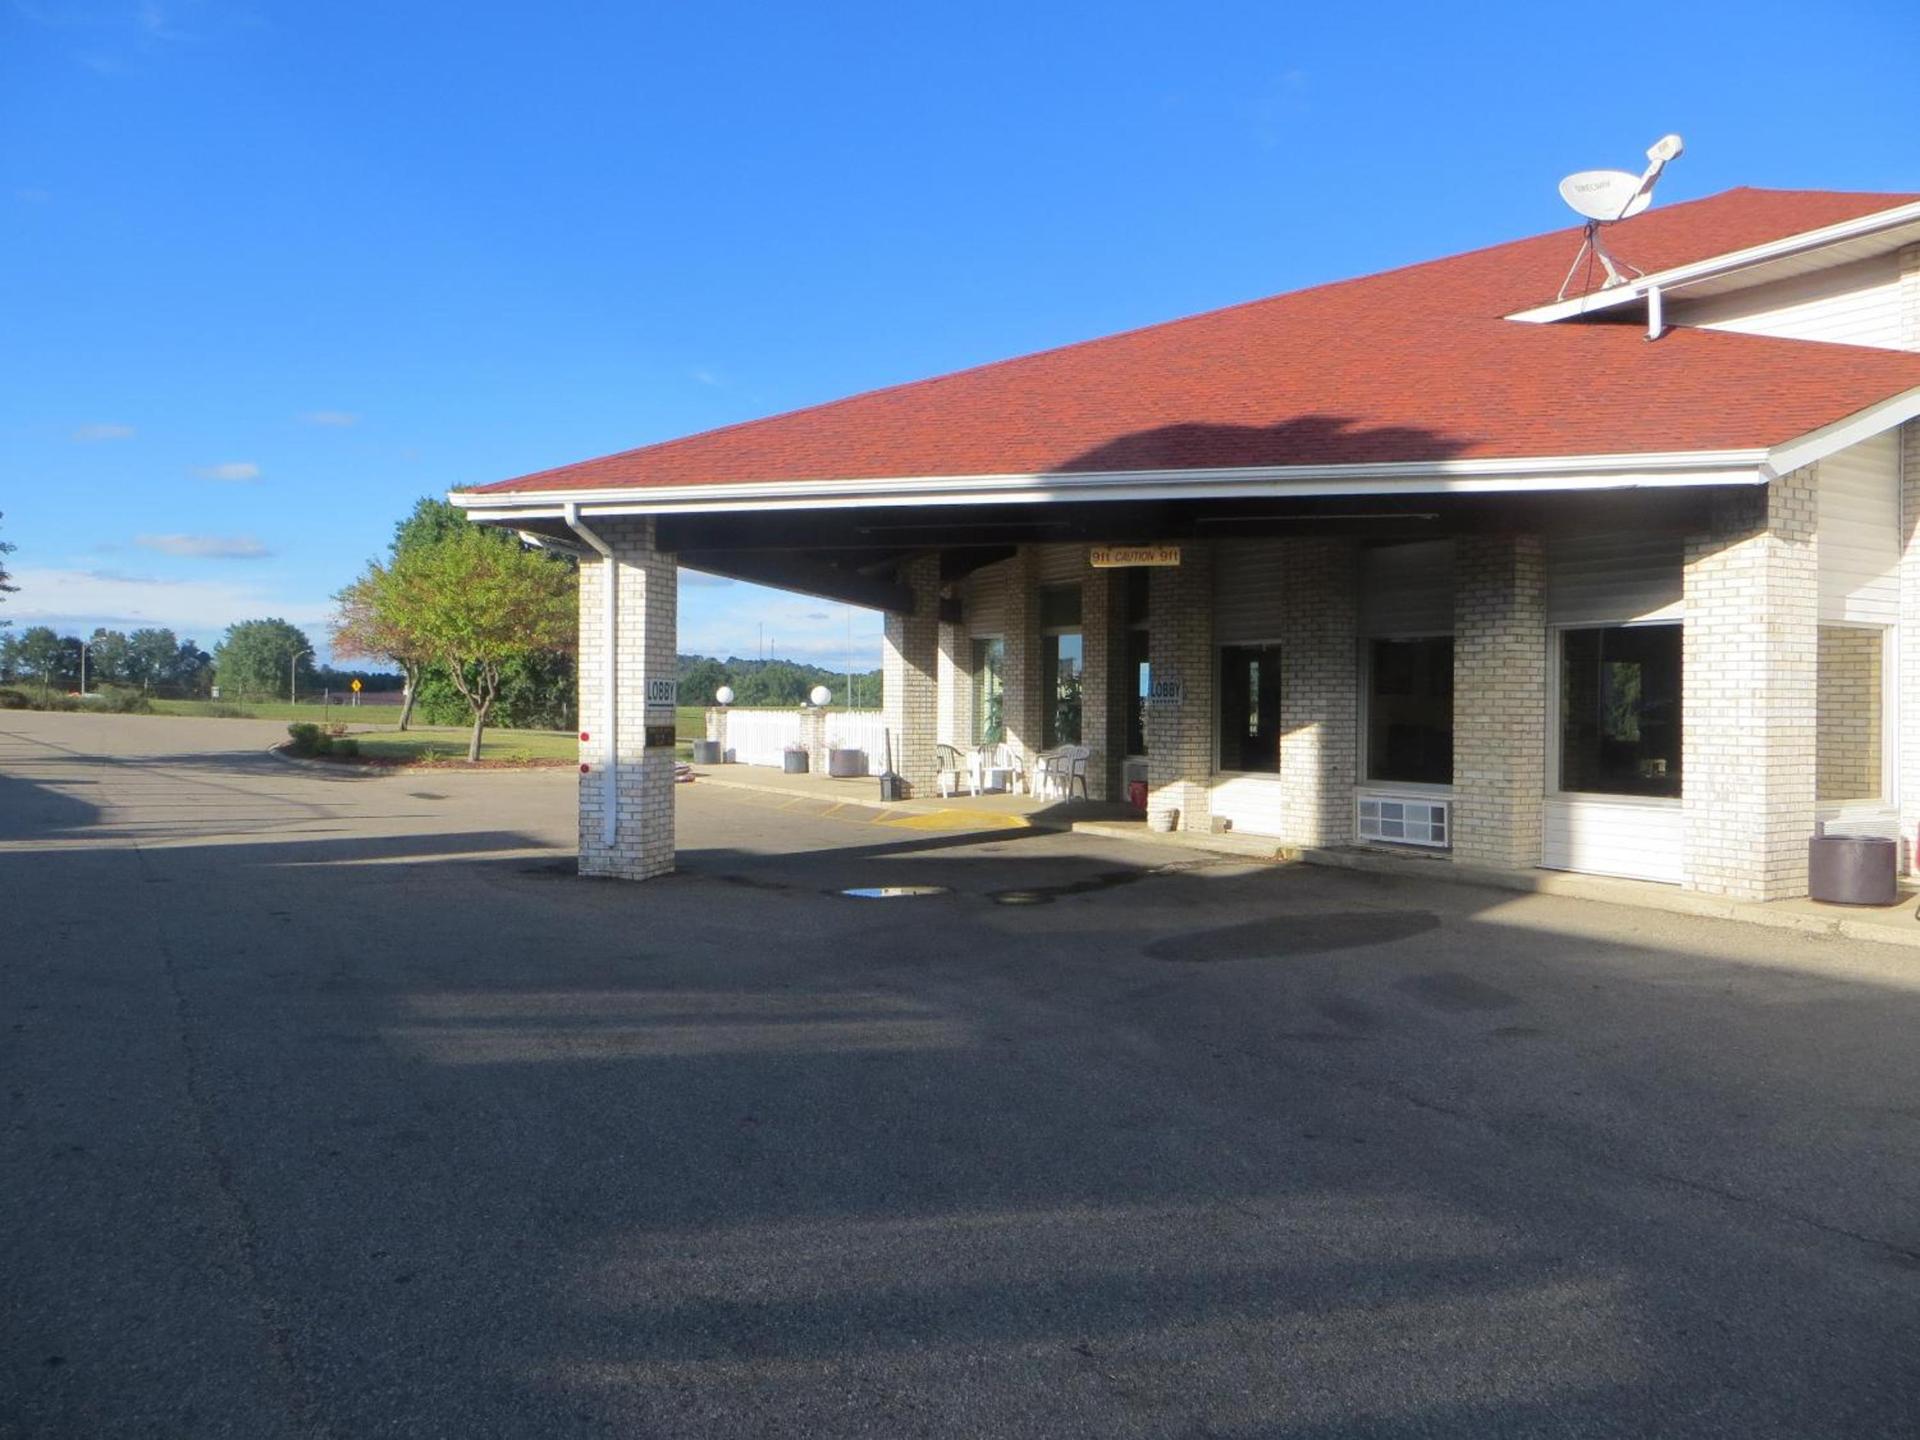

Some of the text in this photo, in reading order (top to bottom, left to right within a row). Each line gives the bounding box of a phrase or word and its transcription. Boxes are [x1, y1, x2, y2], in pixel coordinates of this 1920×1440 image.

[1115, 550, 1154, 562] CAUTION
[647, 680, 676, 700] LOBBY
[1151, 681, 1180, 697] LOBBY
